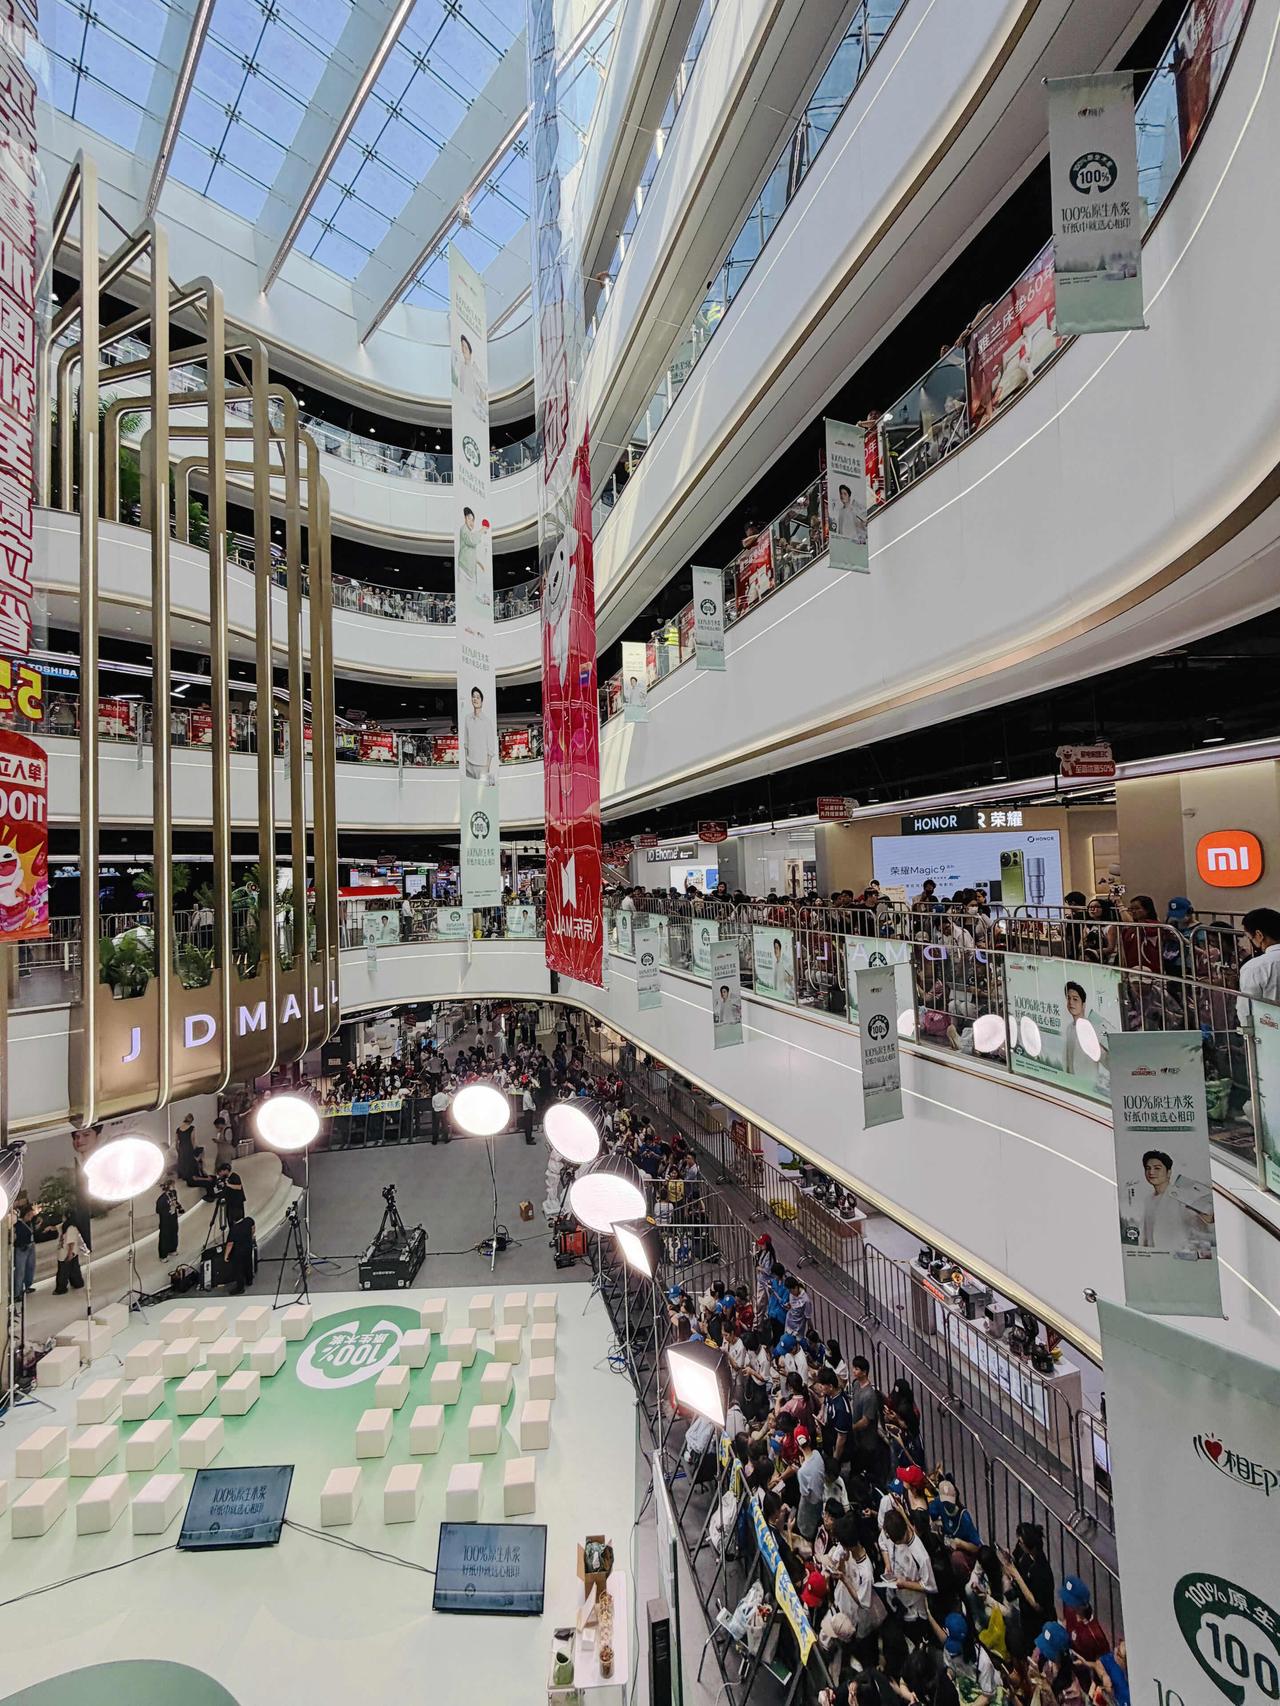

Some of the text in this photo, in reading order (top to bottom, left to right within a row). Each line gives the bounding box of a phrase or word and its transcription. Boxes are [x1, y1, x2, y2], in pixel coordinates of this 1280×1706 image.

[1080, 168, 1110, 185] 100%
[1061, 201, 1131, 222] 100%原生木浆
[28, 664, 78, 679] TOSHIBA
[914, 814, 958, 831] HONOR
[990, 810, 1023, 828] 荣耀
[1123, 1094, 1194, 1110] 100%原生木浆
[1123, 1110, 1195, 1123] 好纸巾就选心相印
[1184, 1580, 1280, 1637] 100%原生
